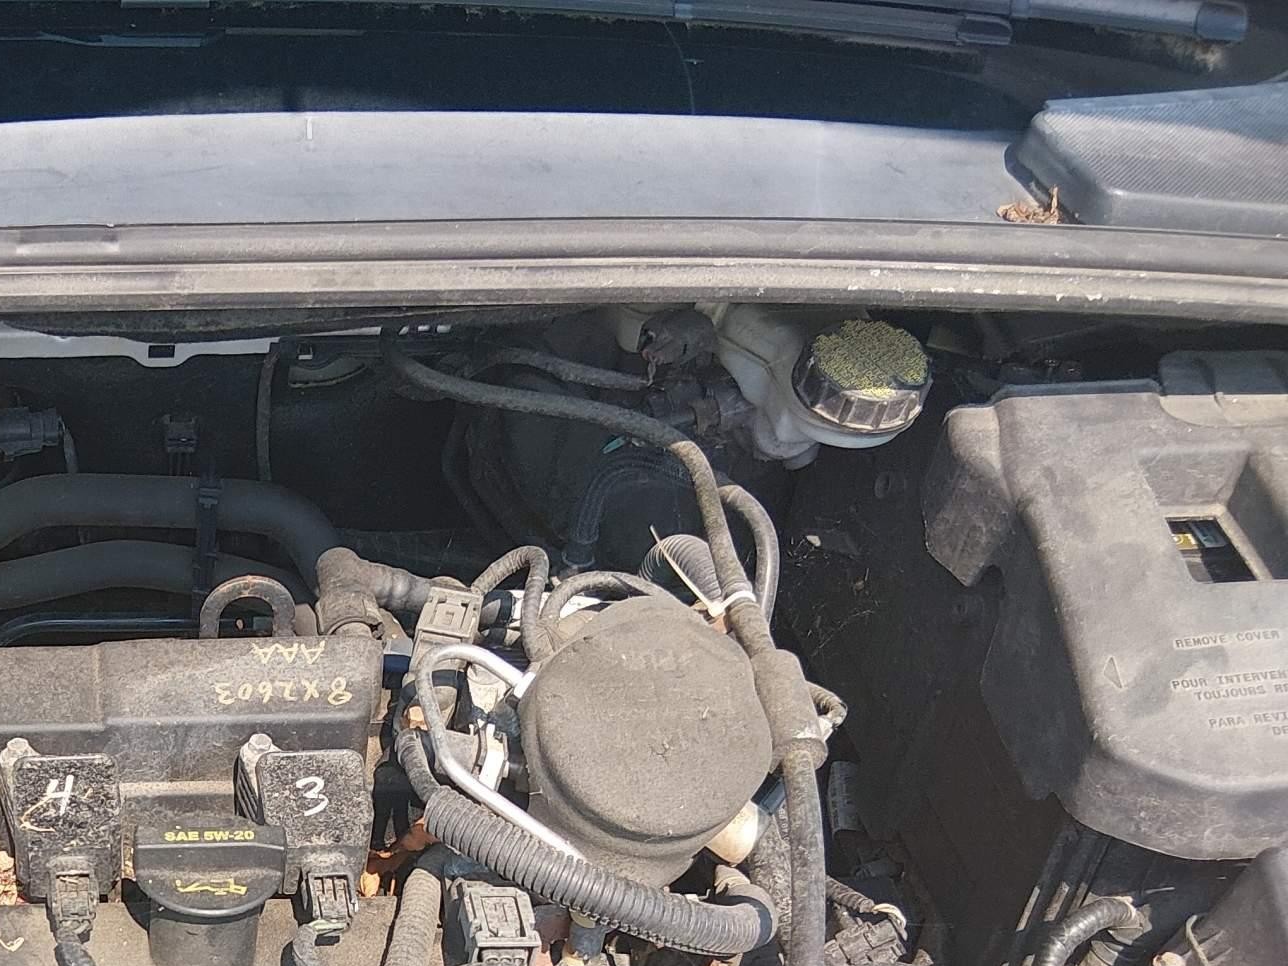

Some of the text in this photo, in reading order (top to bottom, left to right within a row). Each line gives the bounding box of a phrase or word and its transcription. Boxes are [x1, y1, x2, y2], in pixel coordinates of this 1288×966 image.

[1174, 630, 1280, 649] REMOVE COVER
[1171, 678, 1208, 690] POUR
[1194, 685, 1266, 701] TOUJOURS
[1208, 716, 1246, 728] PARA
[295, 776, 329, 817] 3
[164, 830, 255, 842] SAE 5W-20
